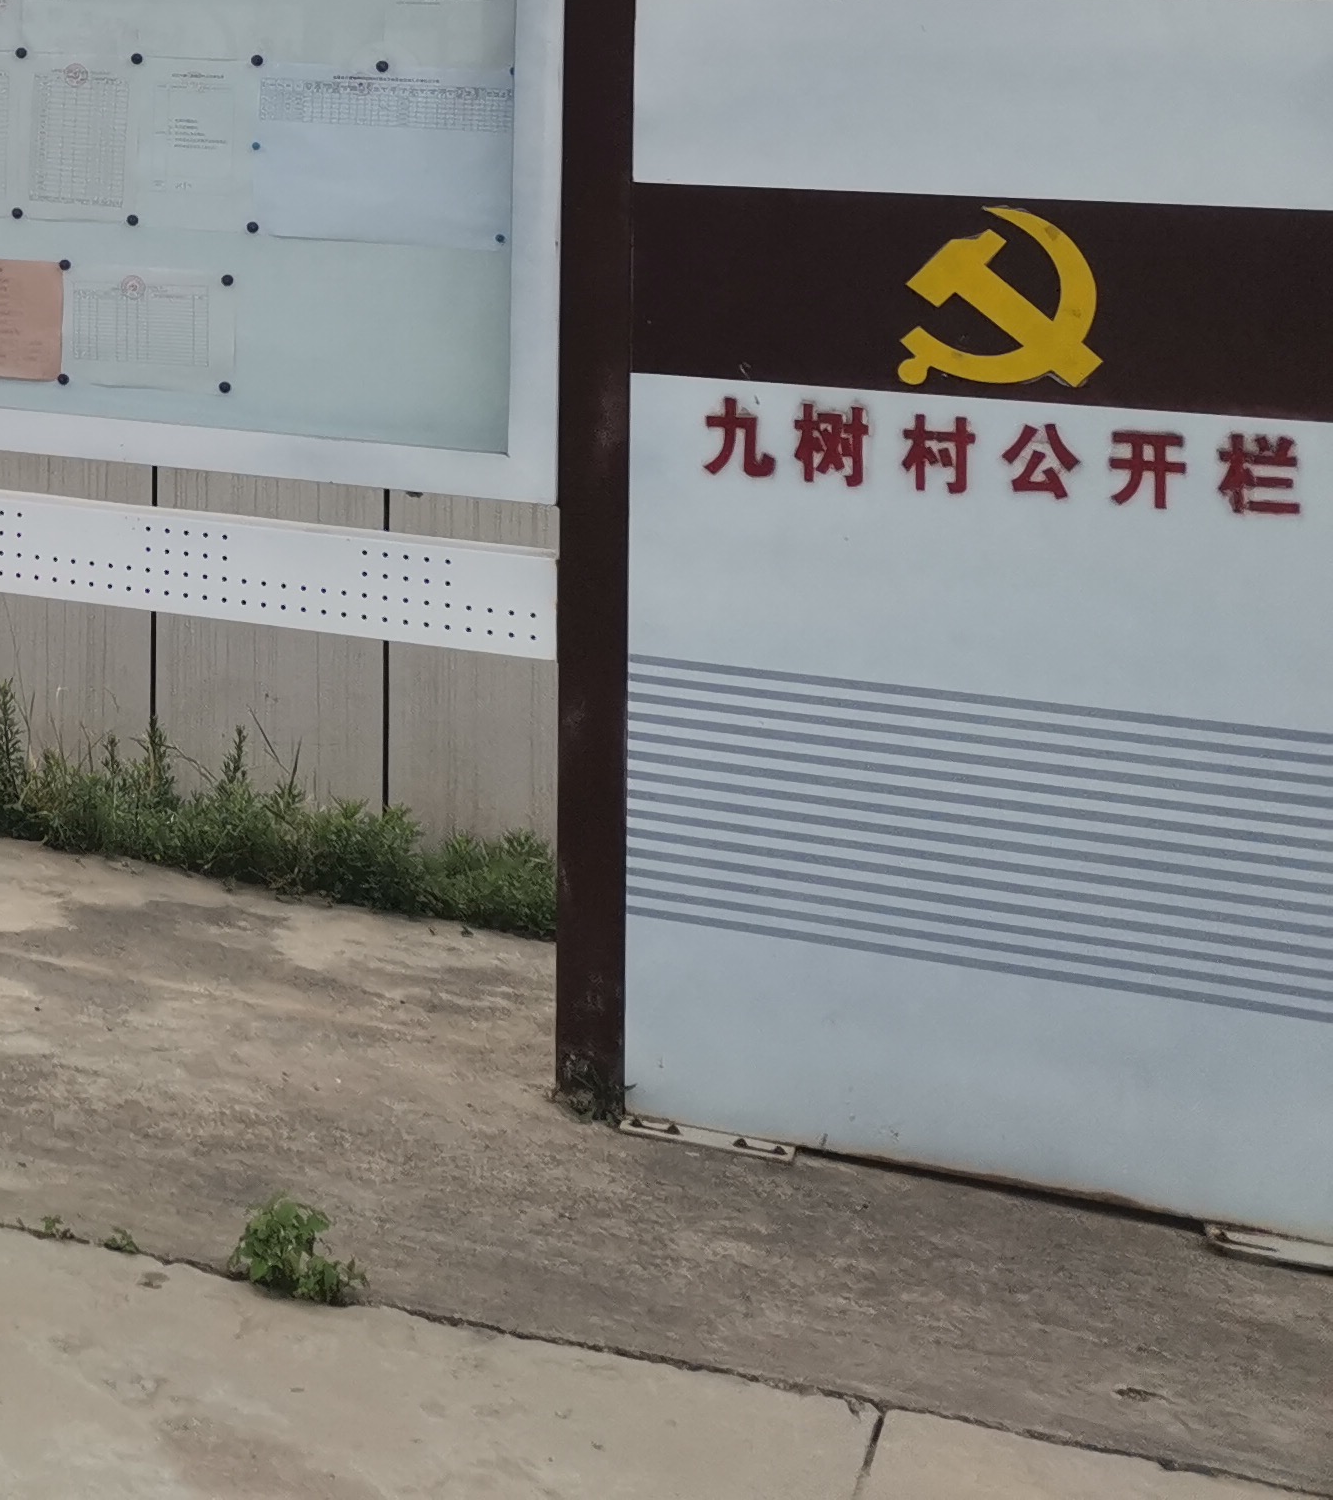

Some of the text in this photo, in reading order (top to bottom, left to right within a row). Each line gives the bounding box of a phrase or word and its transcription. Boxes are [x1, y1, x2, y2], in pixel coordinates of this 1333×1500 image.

[704, 396, 1301, 516] 九树村公开栏
